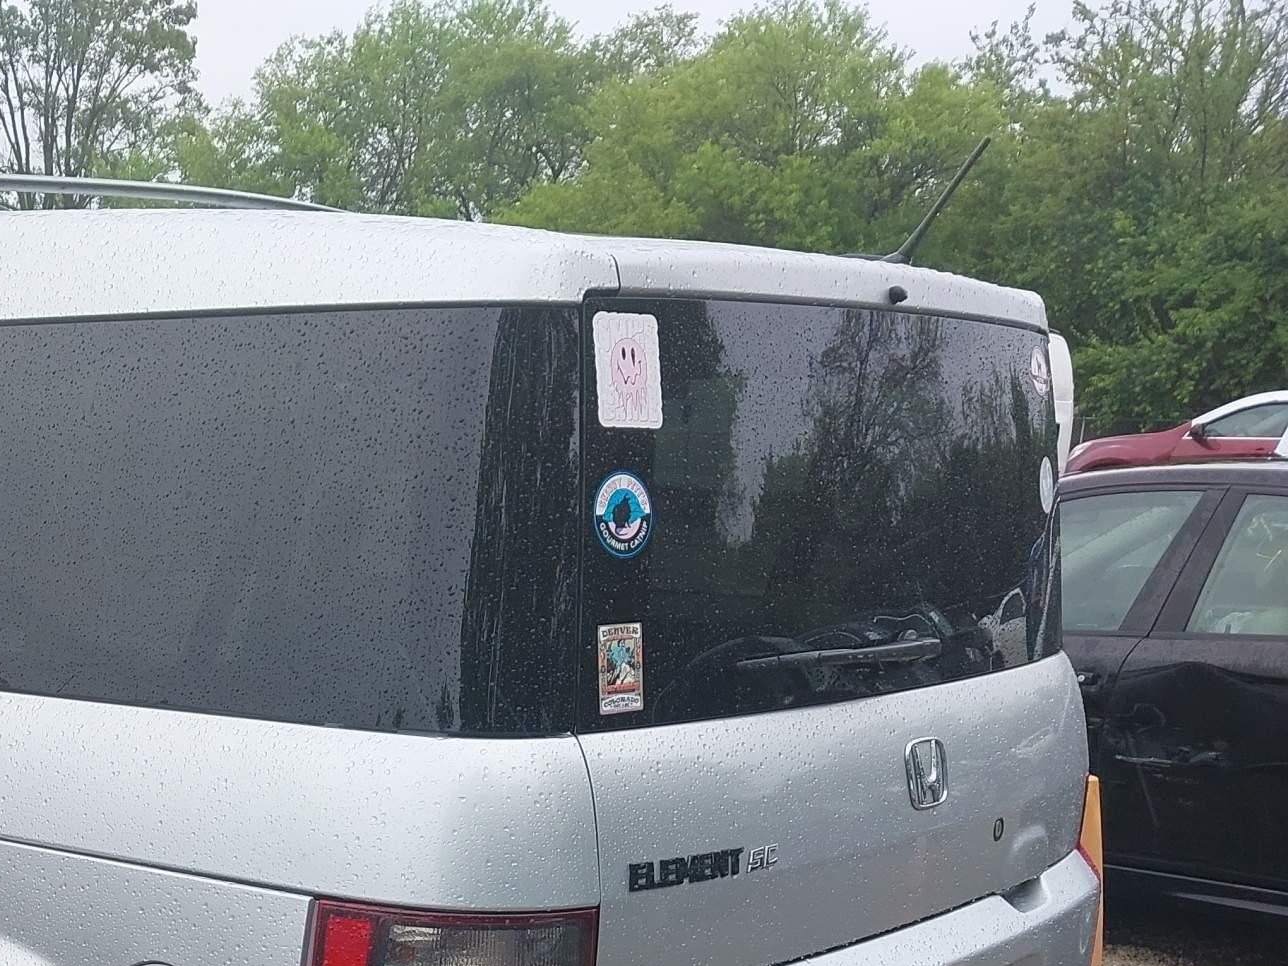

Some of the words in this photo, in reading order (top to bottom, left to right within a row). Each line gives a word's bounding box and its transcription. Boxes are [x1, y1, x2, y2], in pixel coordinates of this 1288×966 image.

[599, 521, 629, 551] GOURMET
[630, 521, 649, 549] CATNIP
[601, 625, 639, 638] DENVER
[603, 696, 640, 708] COLORADO
[628, 846, 745, 892] ELEMENT
[746, 842, 779, 873] SC
